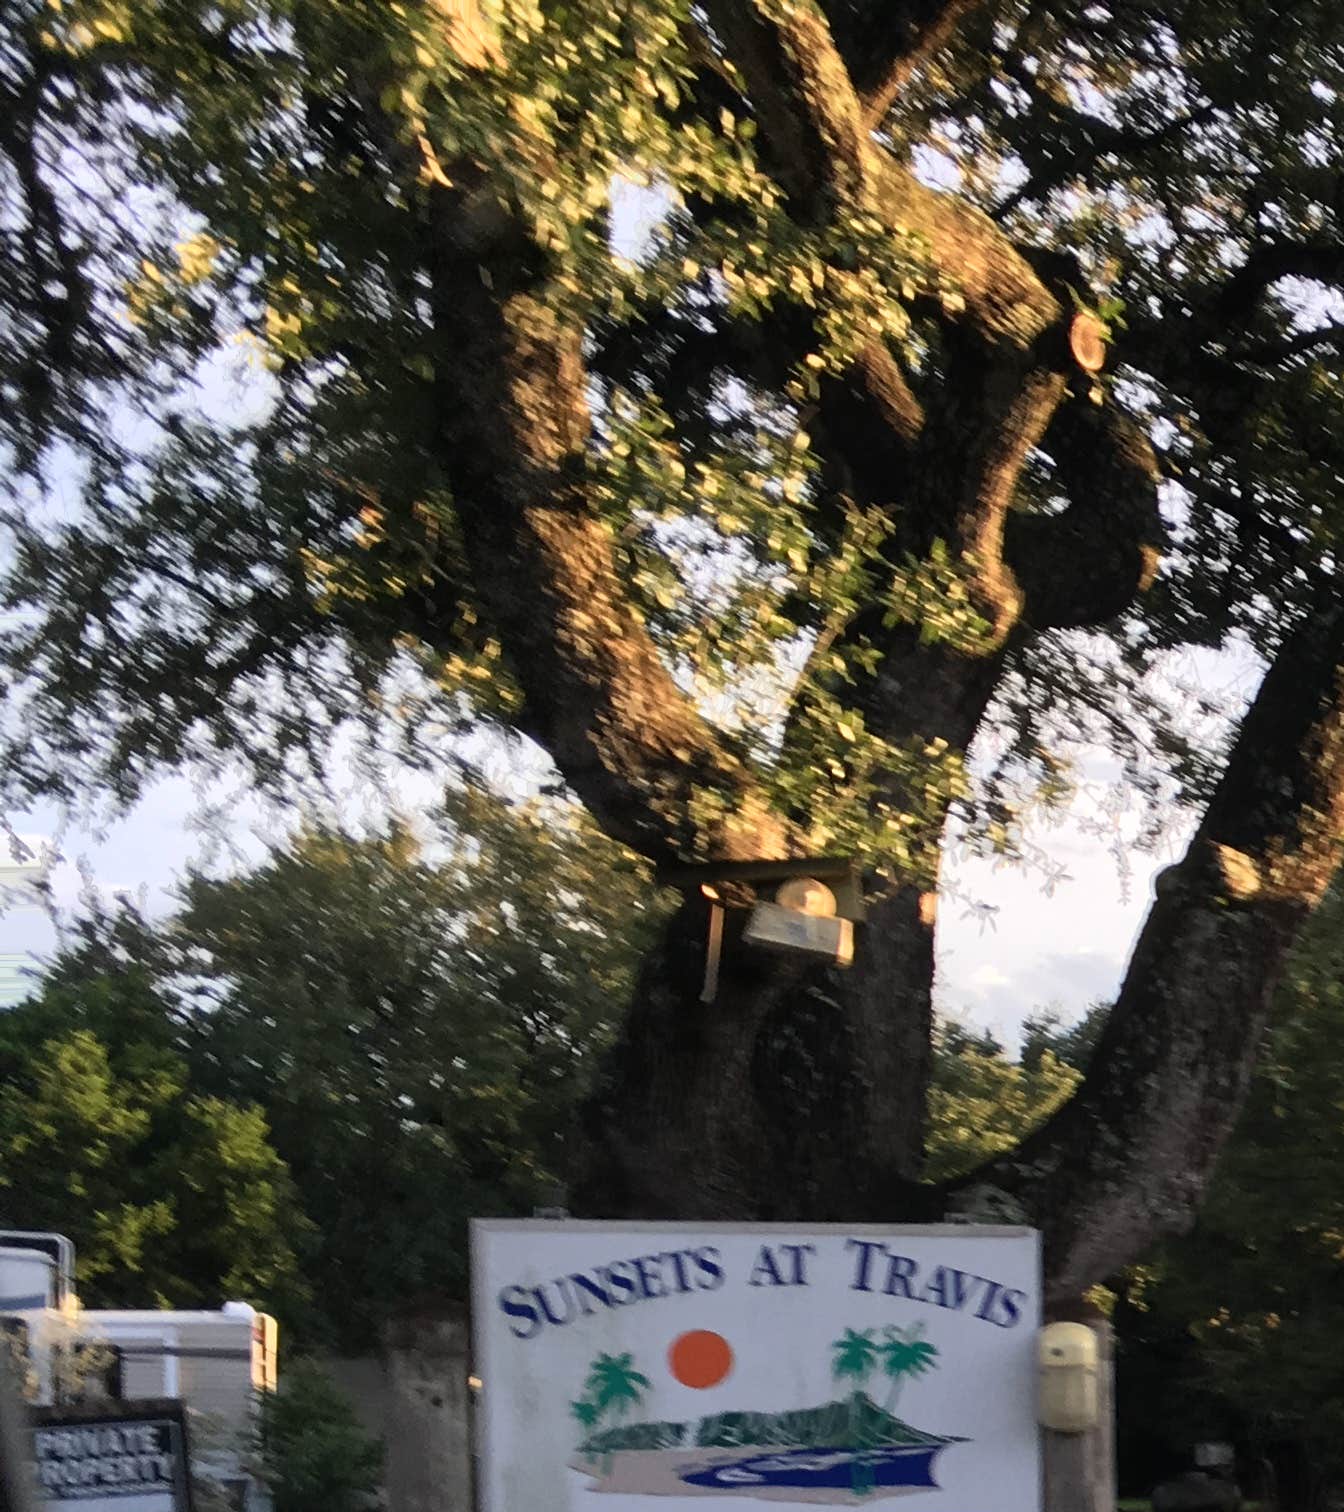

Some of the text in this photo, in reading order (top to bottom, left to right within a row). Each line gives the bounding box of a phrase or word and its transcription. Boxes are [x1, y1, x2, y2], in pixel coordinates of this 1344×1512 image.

[500, 1238, 1028, 1339] SUNSETS AT TRAVIS
